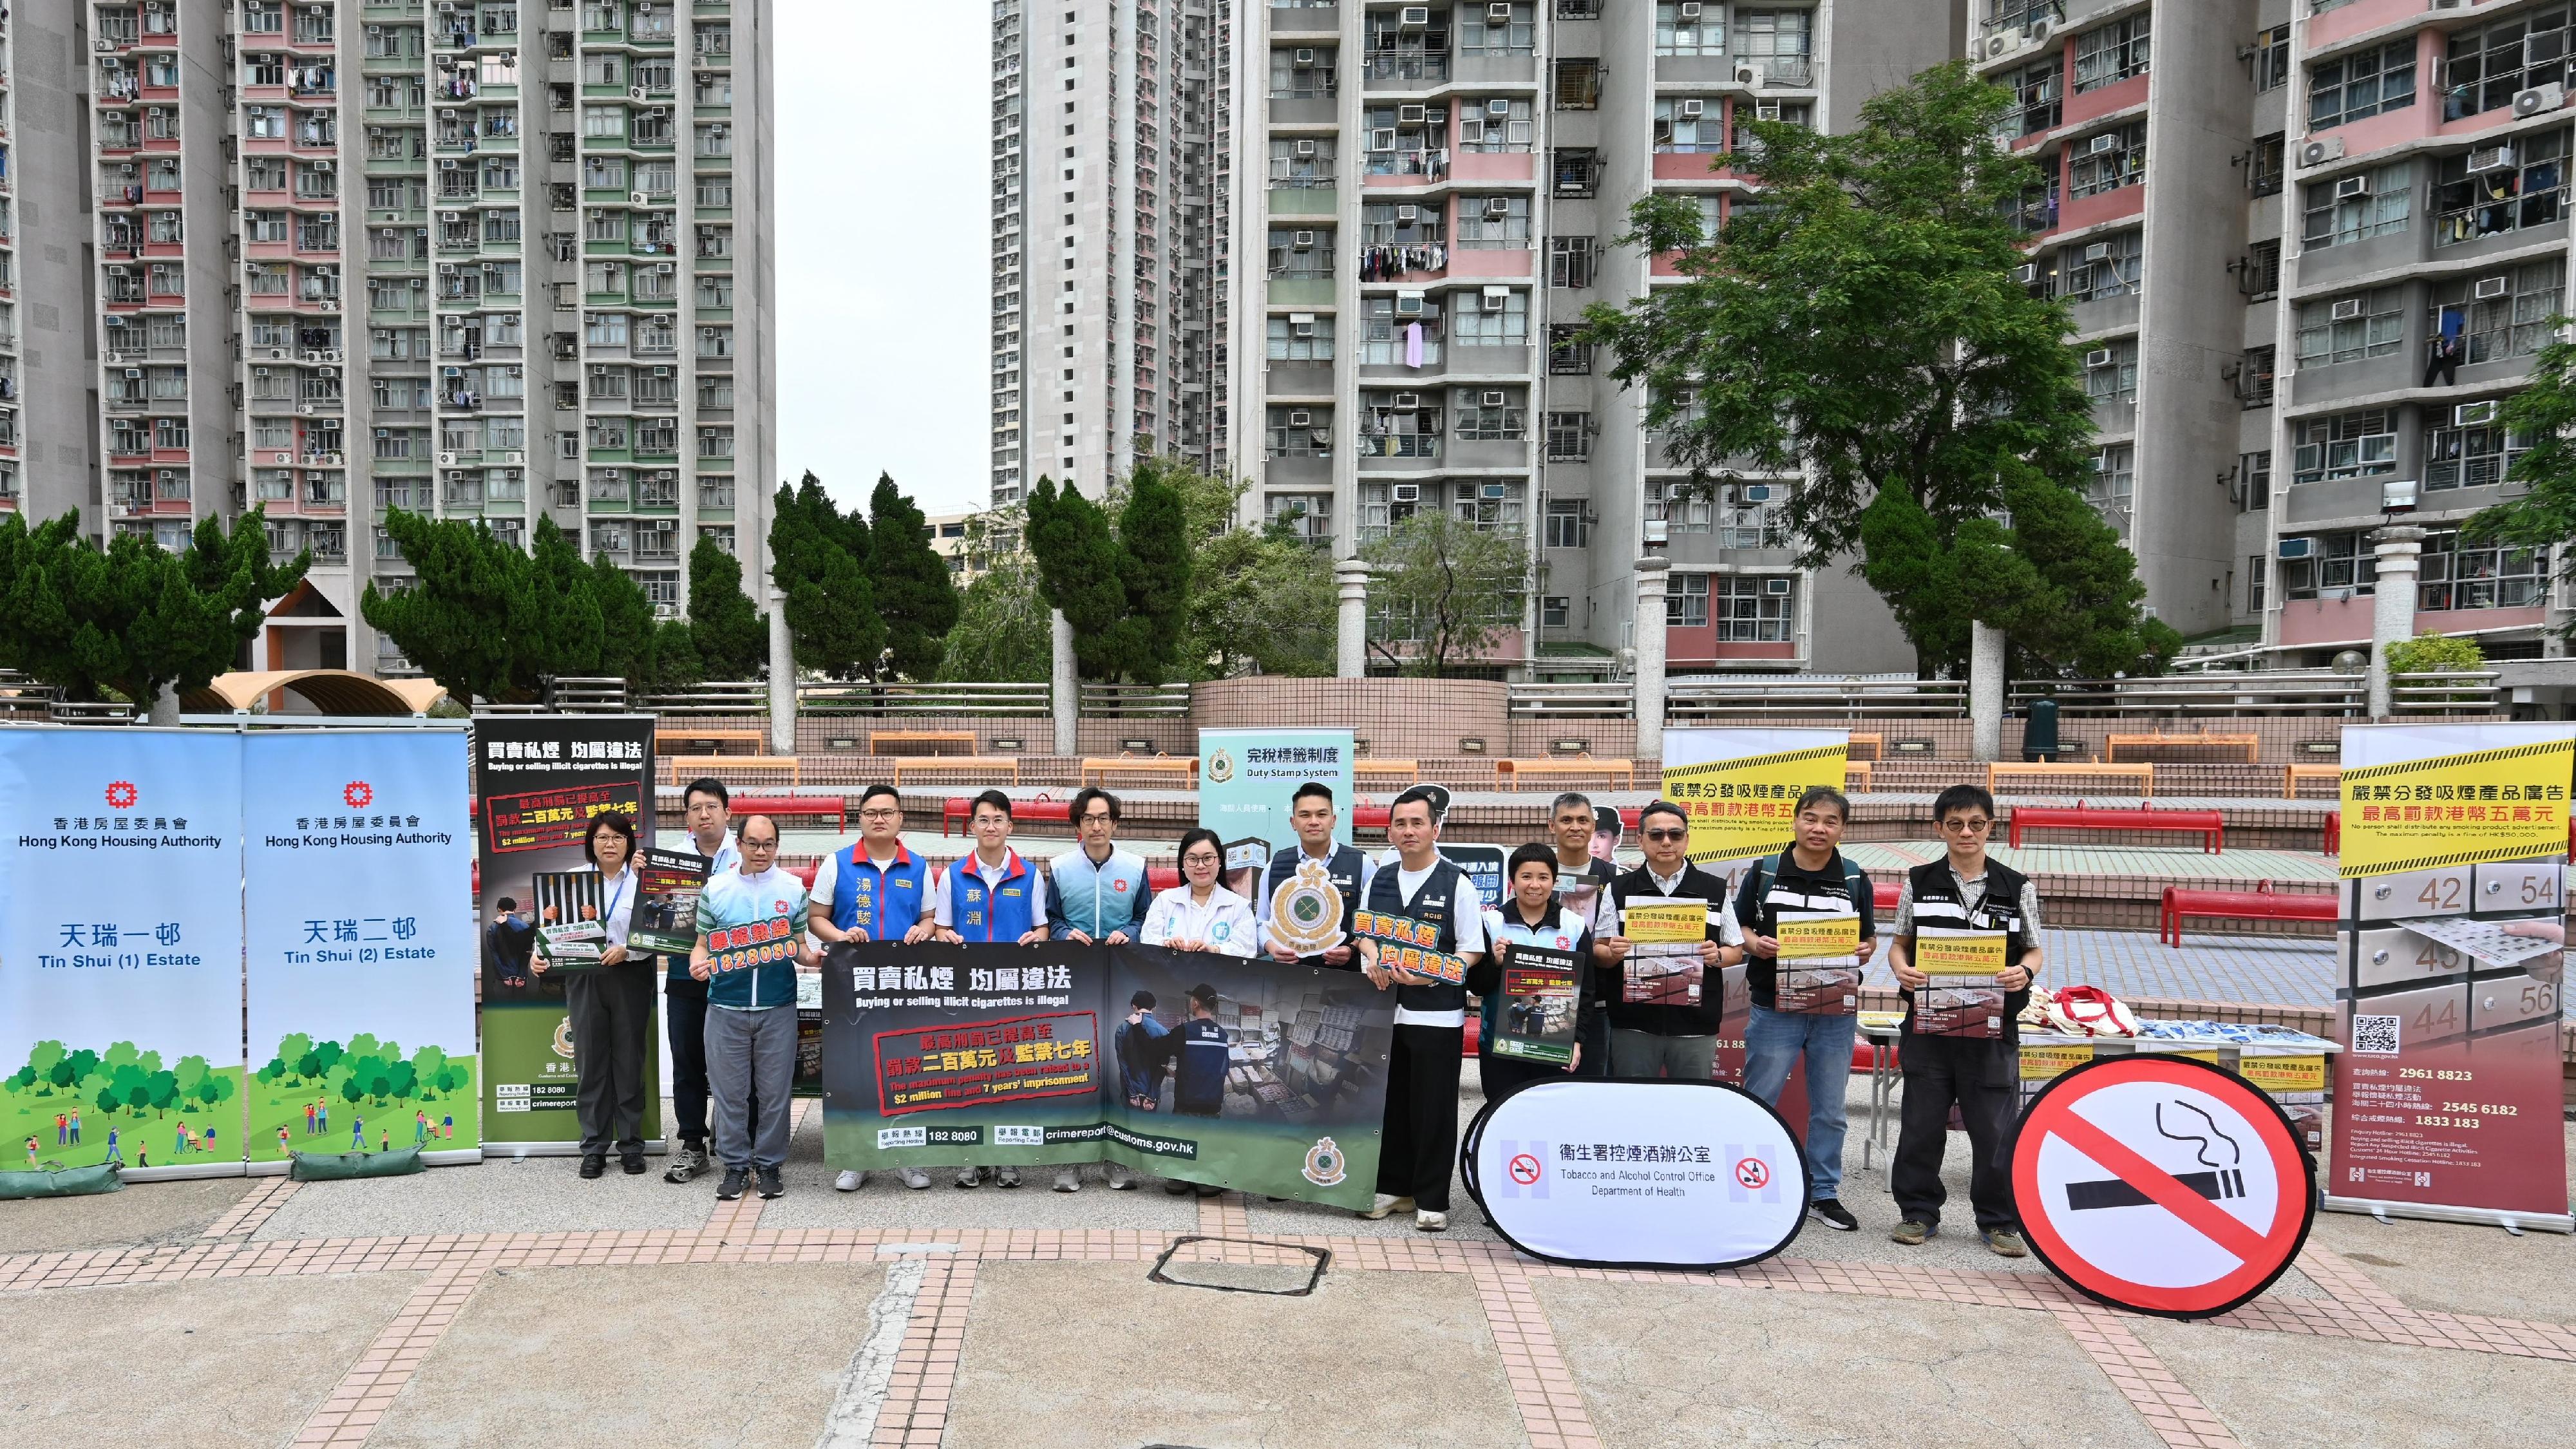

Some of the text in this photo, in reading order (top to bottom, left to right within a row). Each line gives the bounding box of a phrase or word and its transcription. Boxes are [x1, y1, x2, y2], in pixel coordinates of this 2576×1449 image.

[488, 742, 642, 759] 買賣私煙 均屬違法
[1247, 747, 1338, 763] 完稅標籤制度
[488, 762, 514, 772] Buying
[525, 762, 551, 772] selling
[573, 762, 609, 771] cigarettes
[620, 762, 642, 770] illegal
[1247, 769, 1338, 779] Duty Stamp System
[2352, 784, 2564, 801] 嚴禁分發吸煙產品廣告
[296, 815, 421, 830] 香港房屋委員會
[2363, 806, 2553, 822] 最高罰款港幣五萬元
[53, 817, 187, 830] 香港房屋委員會
[19, 835, 222, 849] Hong Kong Housing Authority
[265, 831, 452, 849] Hong Kong Housing Authority
[2418, 876, 2461, 910] 42
[2521, 876, 2553, 904] 54
[856, 876, 871, 927] 湯德駿
[966, 888, 981, 926] 蘇淵
[60, 922, 181, 947] 天瑞一邨
[304, 917, 416, 944] 天瑞二邨
[710, 918, 790, 951] 舉報熱線
[1354, 913, 1437, 949] 買賣私煙
[39, 953, 201, 970] Tin Shui (1) Estate
[284, 947, 436, 964] Tin Shui (2) Estate
[708, 940, 797, 973] 1828080
[1380, 944, 1463, 982] 均屬違法
[853, 965, 1072, 991] 買賣私煙 均屬違法
[856, 998, 890, 1009] Buying
[907, 997, 940, 1008] selling
[943, 996, 969, 1007] illicit
[971, 996, 1022, 1010] cigarettes
[1025, 996, 1034, 1005] is
[1037, 995, 1068, 1007] illegal
[2519, 983, 2552, 1015] 56
[2412, 999, 2457, 1034] 44
[920, 1023, 1054, 1052] 最高刑罰已提高至
[1716, 1039, 1745, 1048] 61 88
[886, 1039, 1092, 1078] 罰款二百萬元及監禁七年
[889, 1082, 906, 1092] The
[909, 1076, 956, 1089] maximum
[958, 1072, 992, 1086] penalty
[995, 1070, 1012, 1080] has
[1014, 1066, 1038, 1077] been
[1039, 1063, 1070, 1074] raised
[1072, 1063, 1082, 1072] to
[2399, 1068, 2434, 1079] 2961
[2437, 1070, 2472, 1081] 8823
[894, 1073, 1089, 1106] $2 million fine and 7 years' imprisonment
[2442, 1102, 2477, 1113] 2545
[2481, 1104, 2517, 1116] 6182
[2416, 1115, 2449, 1126] 1833
[2454, 1118, 2479, 1128] 183
[929, 1130, 977, 1141] 182 8080
[1046, 1125, 1193, 1155] crimereport@customs.gov.hk
[1561, 1170, 1715, 1182] Tobacco and Alcohol Control Office
[1592, 1186, 1685, 1198] Department of Health
